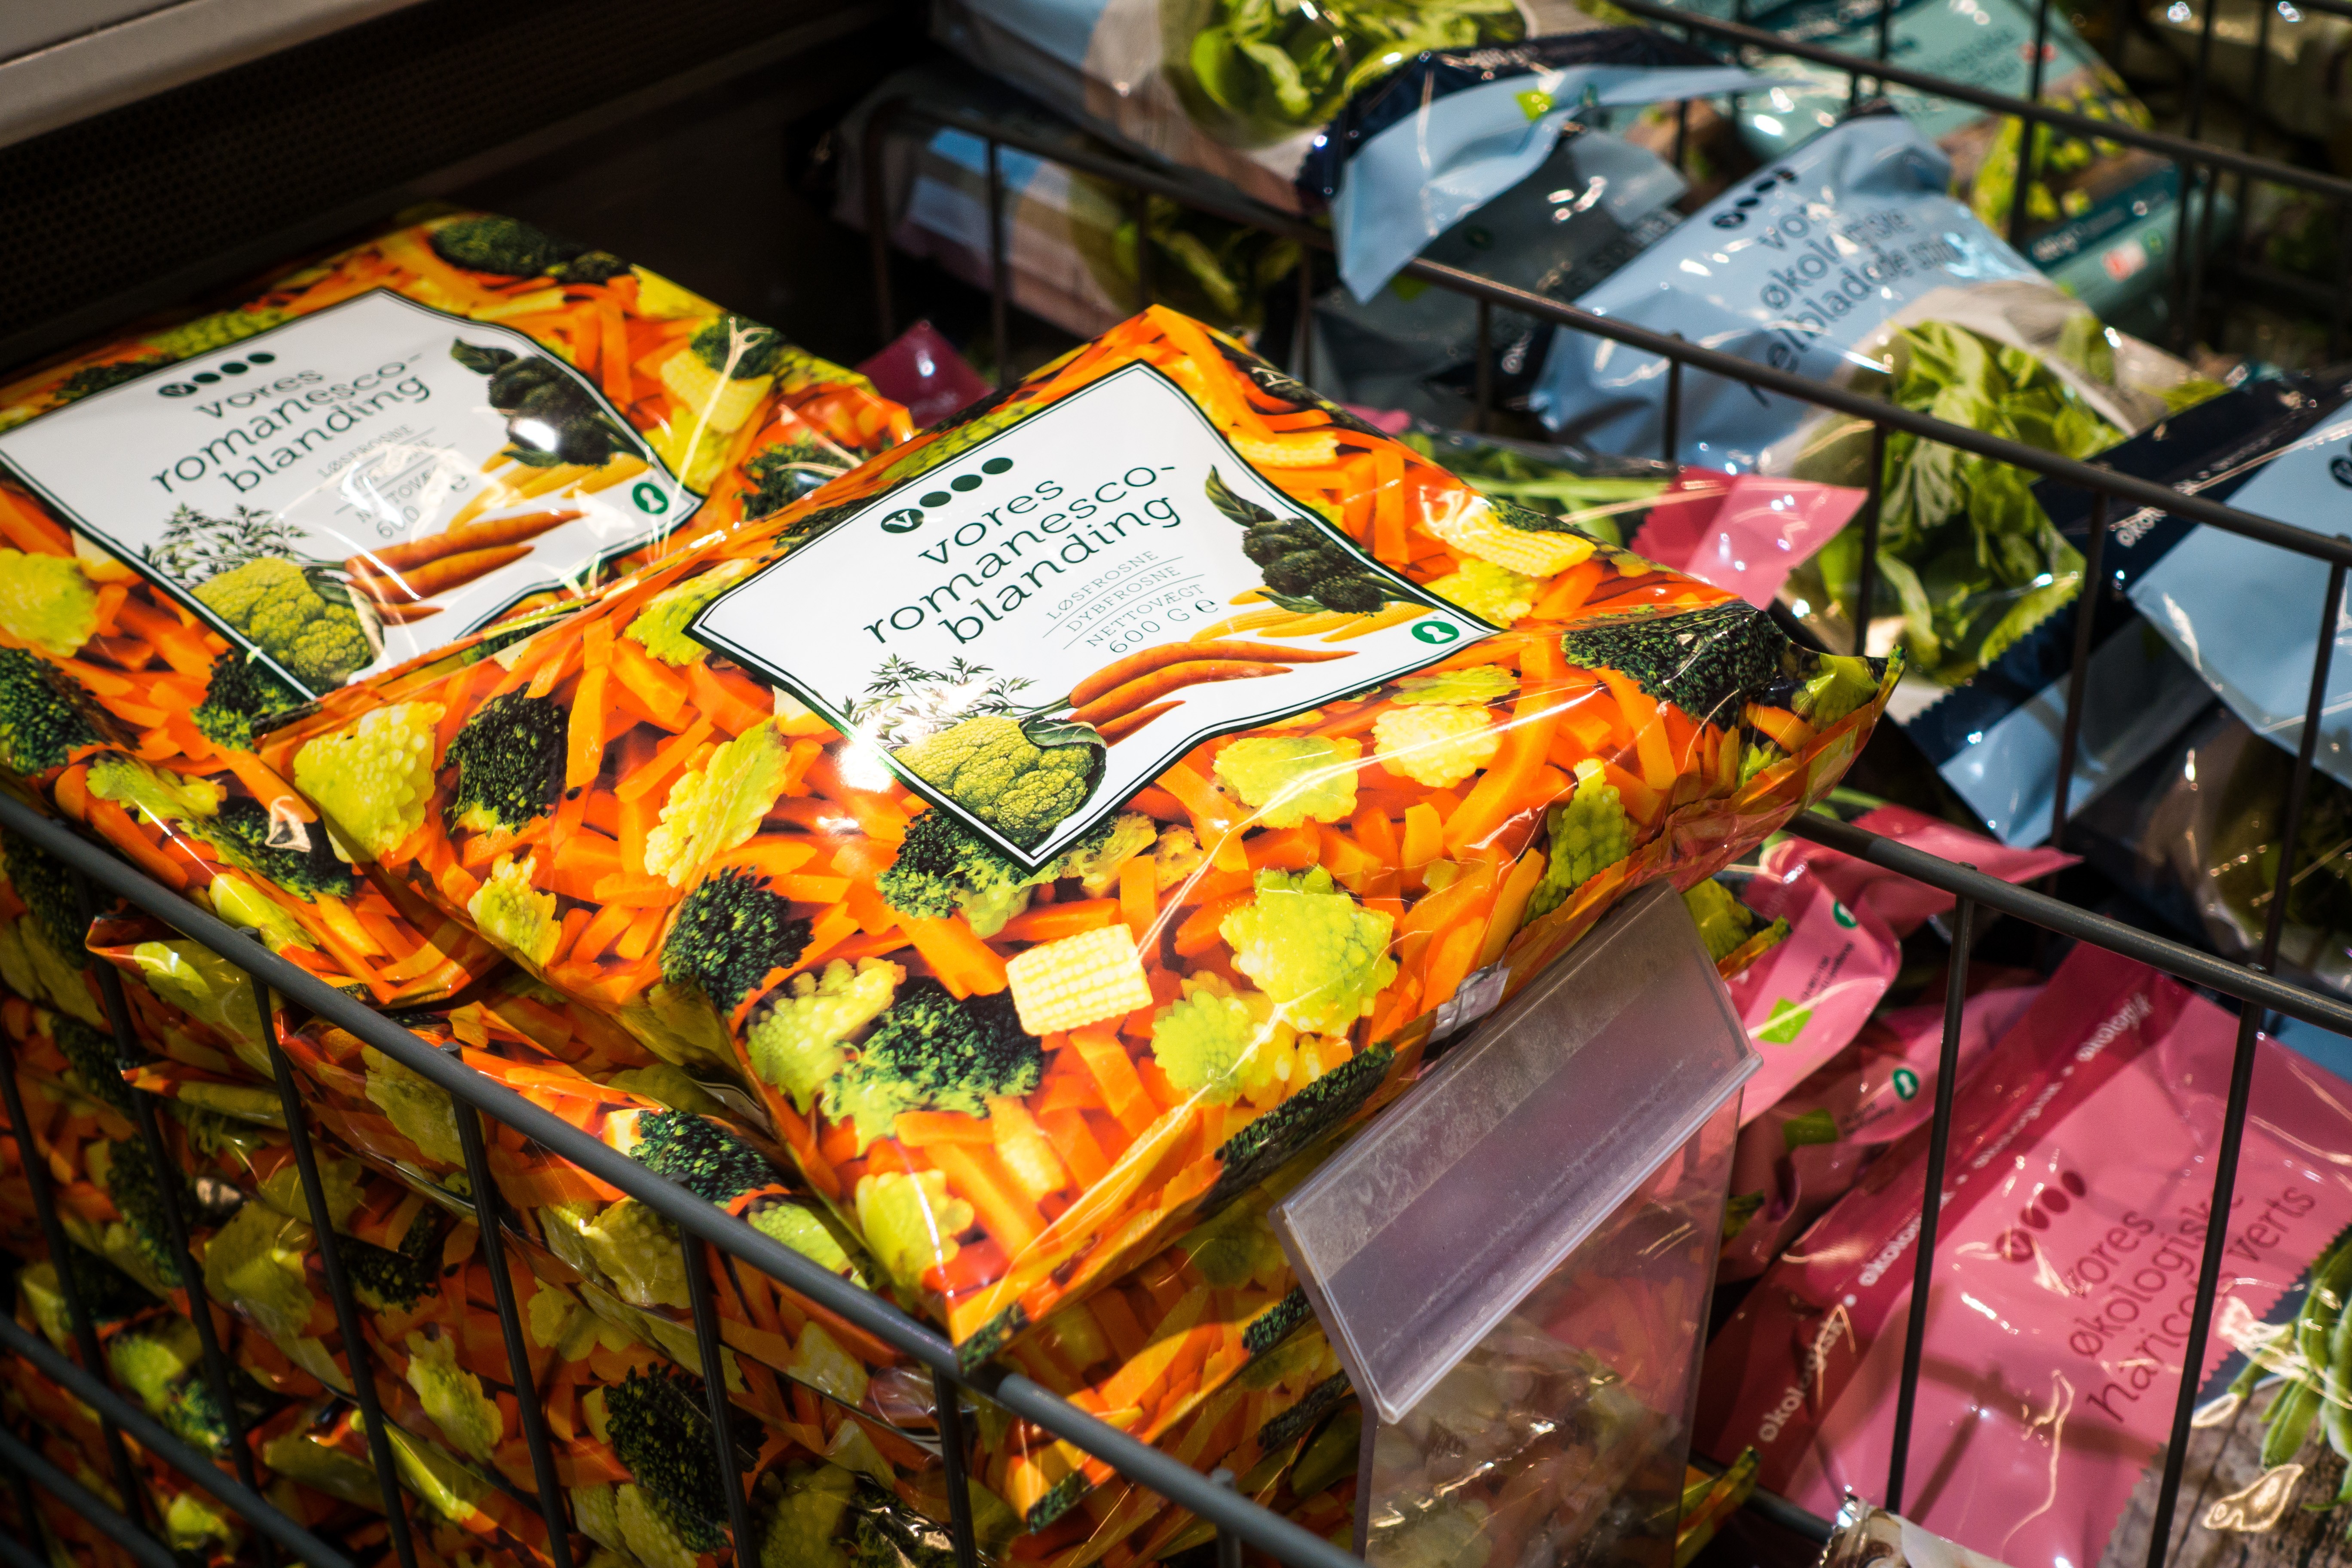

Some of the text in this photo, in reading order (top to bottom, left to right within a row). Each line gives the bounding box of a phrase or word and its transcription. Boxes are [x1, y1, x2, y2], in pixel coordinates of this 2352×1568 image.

[152, 352, 422, 494] romanesco-
[194, 370, 324, 419] vores
[219, 374, 430, 493] blanding
[863, 466, 1176, 644] romanesco-
[918, 480, 1064, 564] vores
[937, 496, 1181, 644] blanding
[1046, 551, 1159, 620] LØSFROSNE
[1066, 567, 1180, 632] DYBFROSNE
[1085, 584, 1205, 647] NETTOVÆGT
[1109, 621, 1160, 653] 600
[1167, 608, 1190, 622] G
[2226, 1186, 2315, 1263] verts
